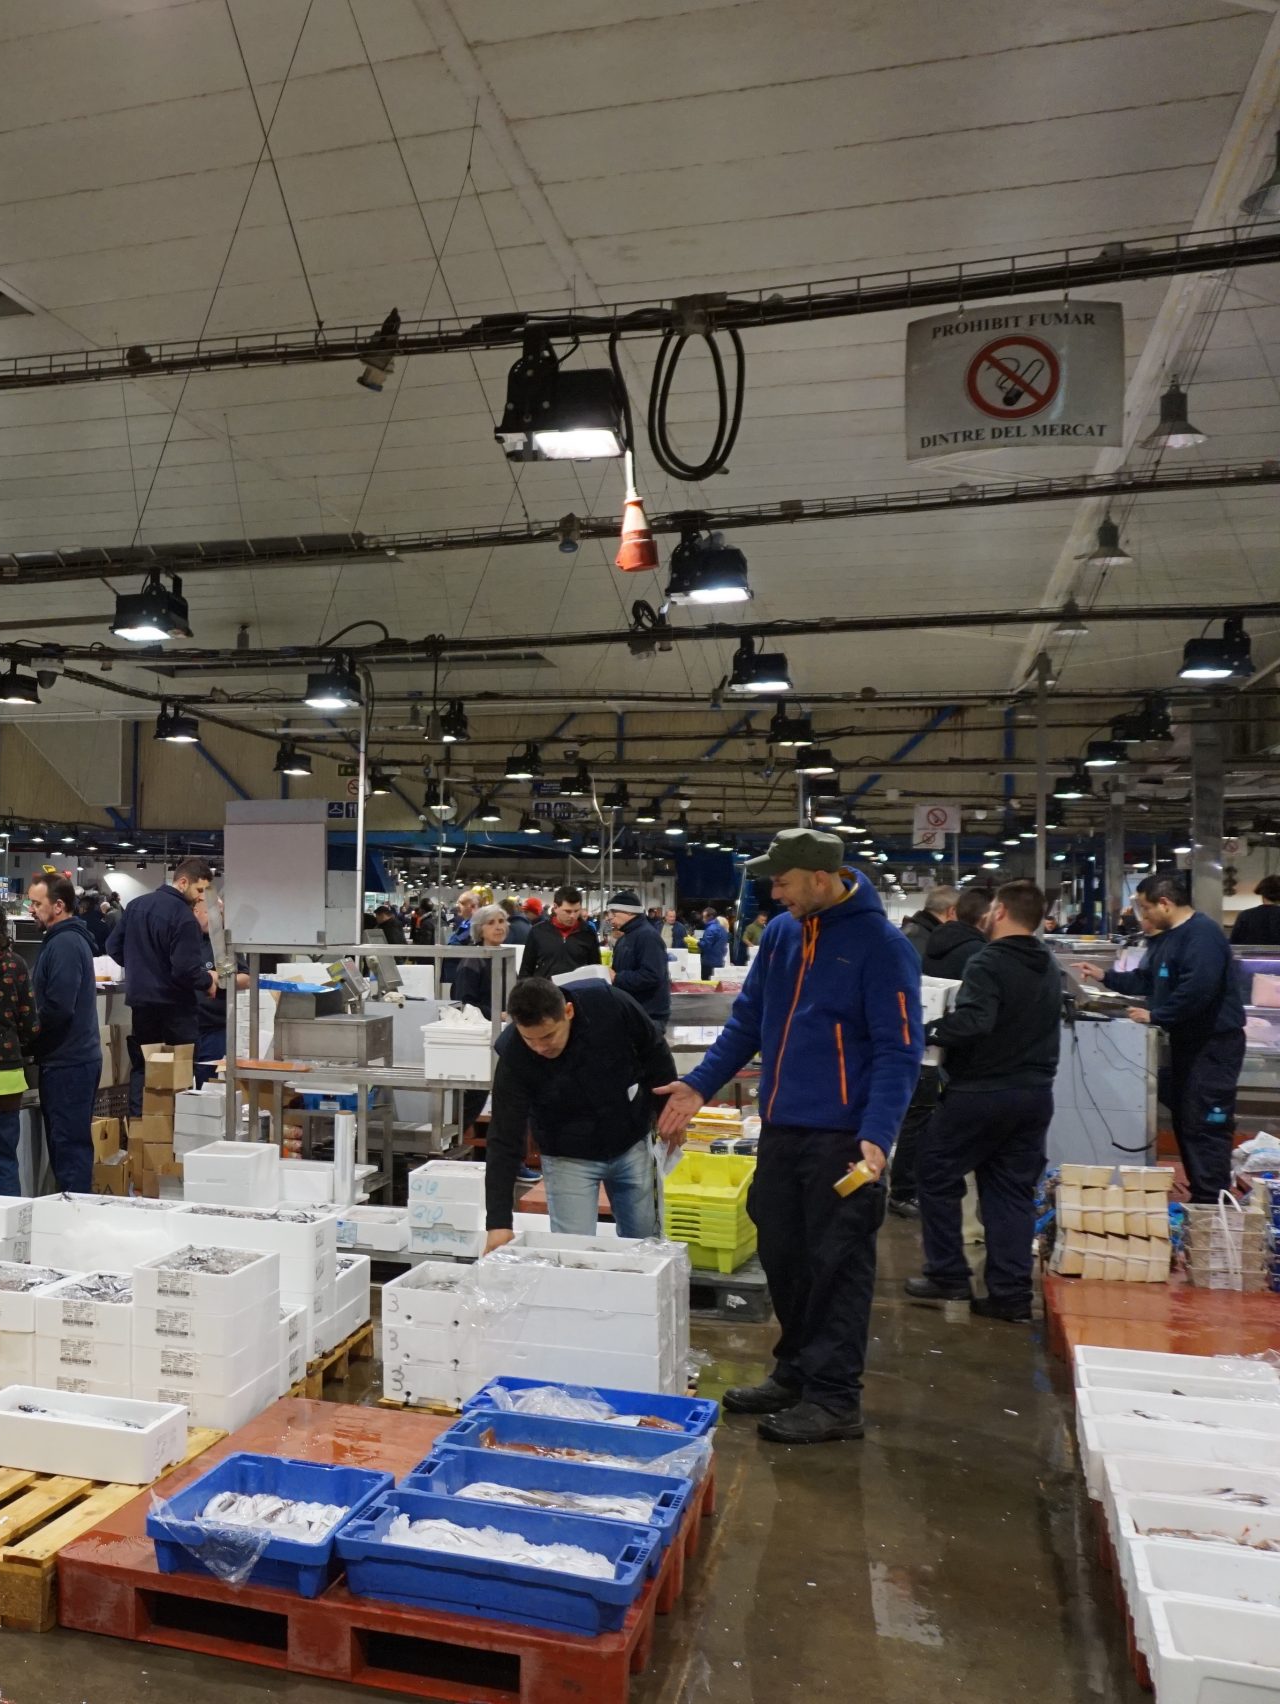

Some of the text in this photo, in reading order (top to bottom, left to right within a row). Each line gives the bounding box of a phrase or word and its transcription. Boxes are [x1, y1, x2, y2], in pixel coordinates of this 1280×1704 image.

[931, 312, 1096, 339] PROHIBIT FUMAR
[920, 423, 1108, 449] DINTRE DEL MERCAT
